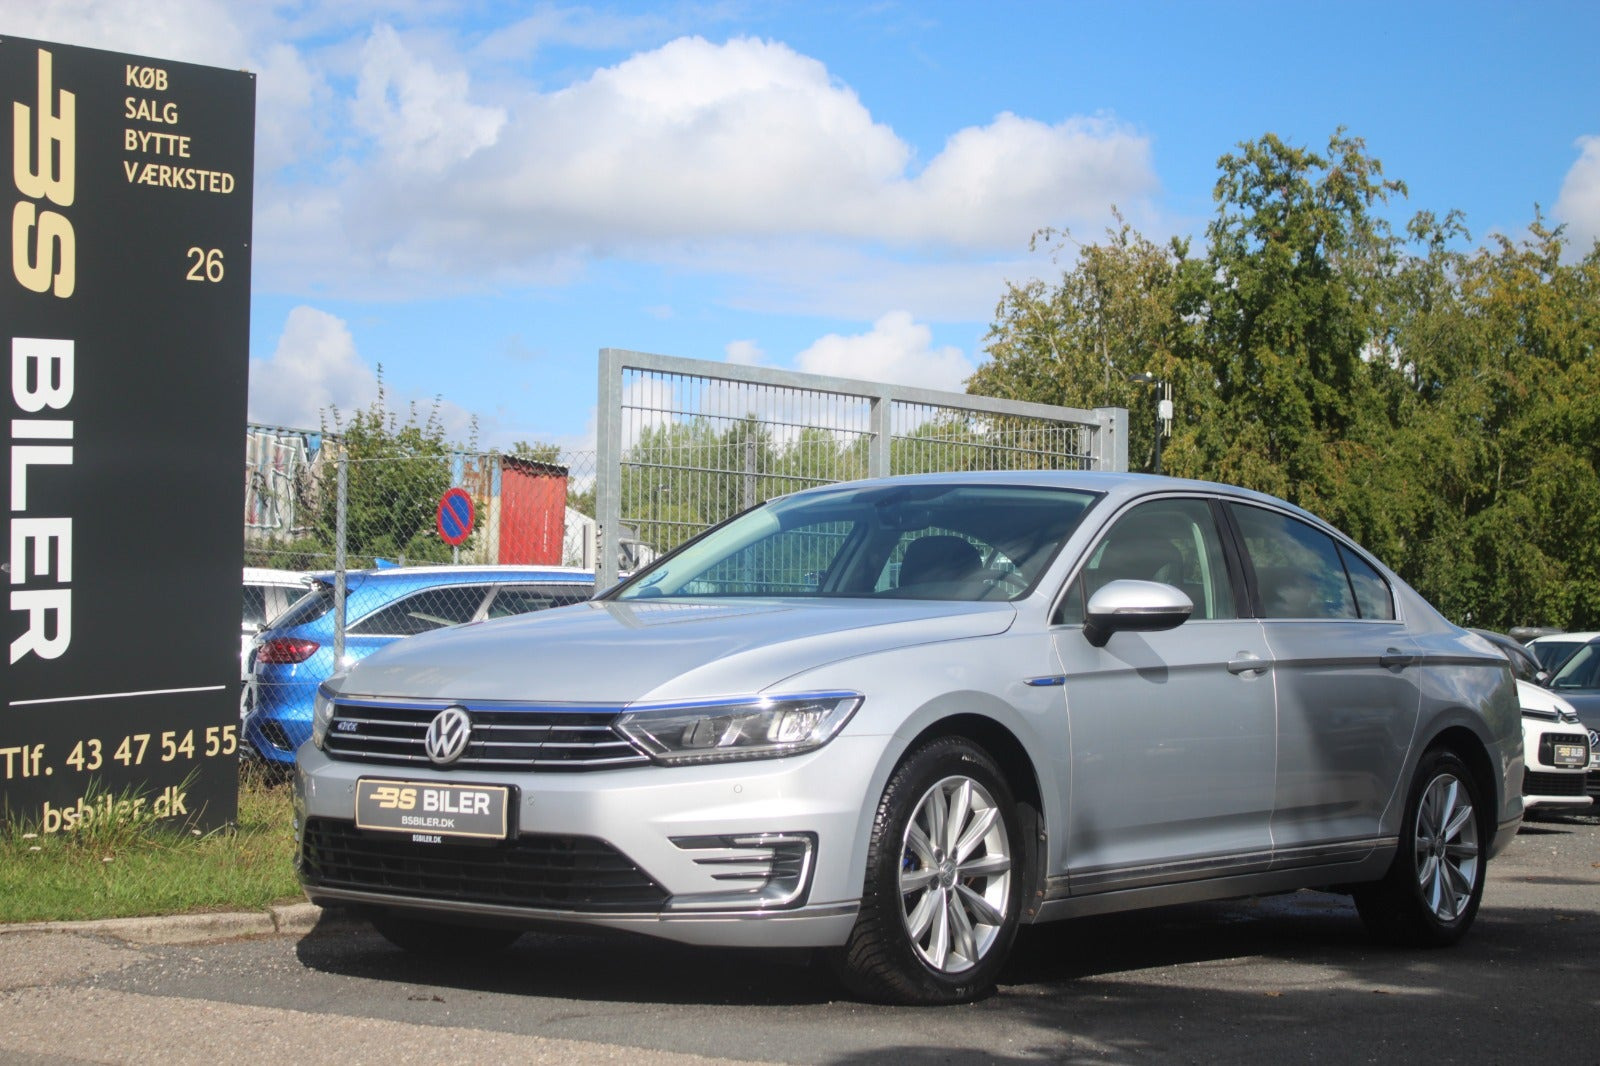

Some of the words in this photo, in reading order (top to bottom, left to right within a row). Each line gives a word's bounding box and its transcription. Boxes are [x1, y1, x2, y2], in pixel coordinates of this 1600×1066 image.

[125, 64, 168, 91] KØB
[124, 97, 179, 124] SALG
[124, 128, 191, 158] BYTTE
[123, 160, 235, 194] VÆRKSTED
[185, 246, 224, 282] 26
[9, 337, 75, 665] BILER
[0, 743, 53, 779] Tlf.
[66, 738, 103, 772] 43
[113, 733, 151, 766] 47
[161, 729, 195, 762] 54
[205, 724, 237, 757] 55
[423, 789, 490, 815] BILER
[401, 815, 455, 828] BSBILER.DK
[412, 834, 442, 844] BSBILER.DK
